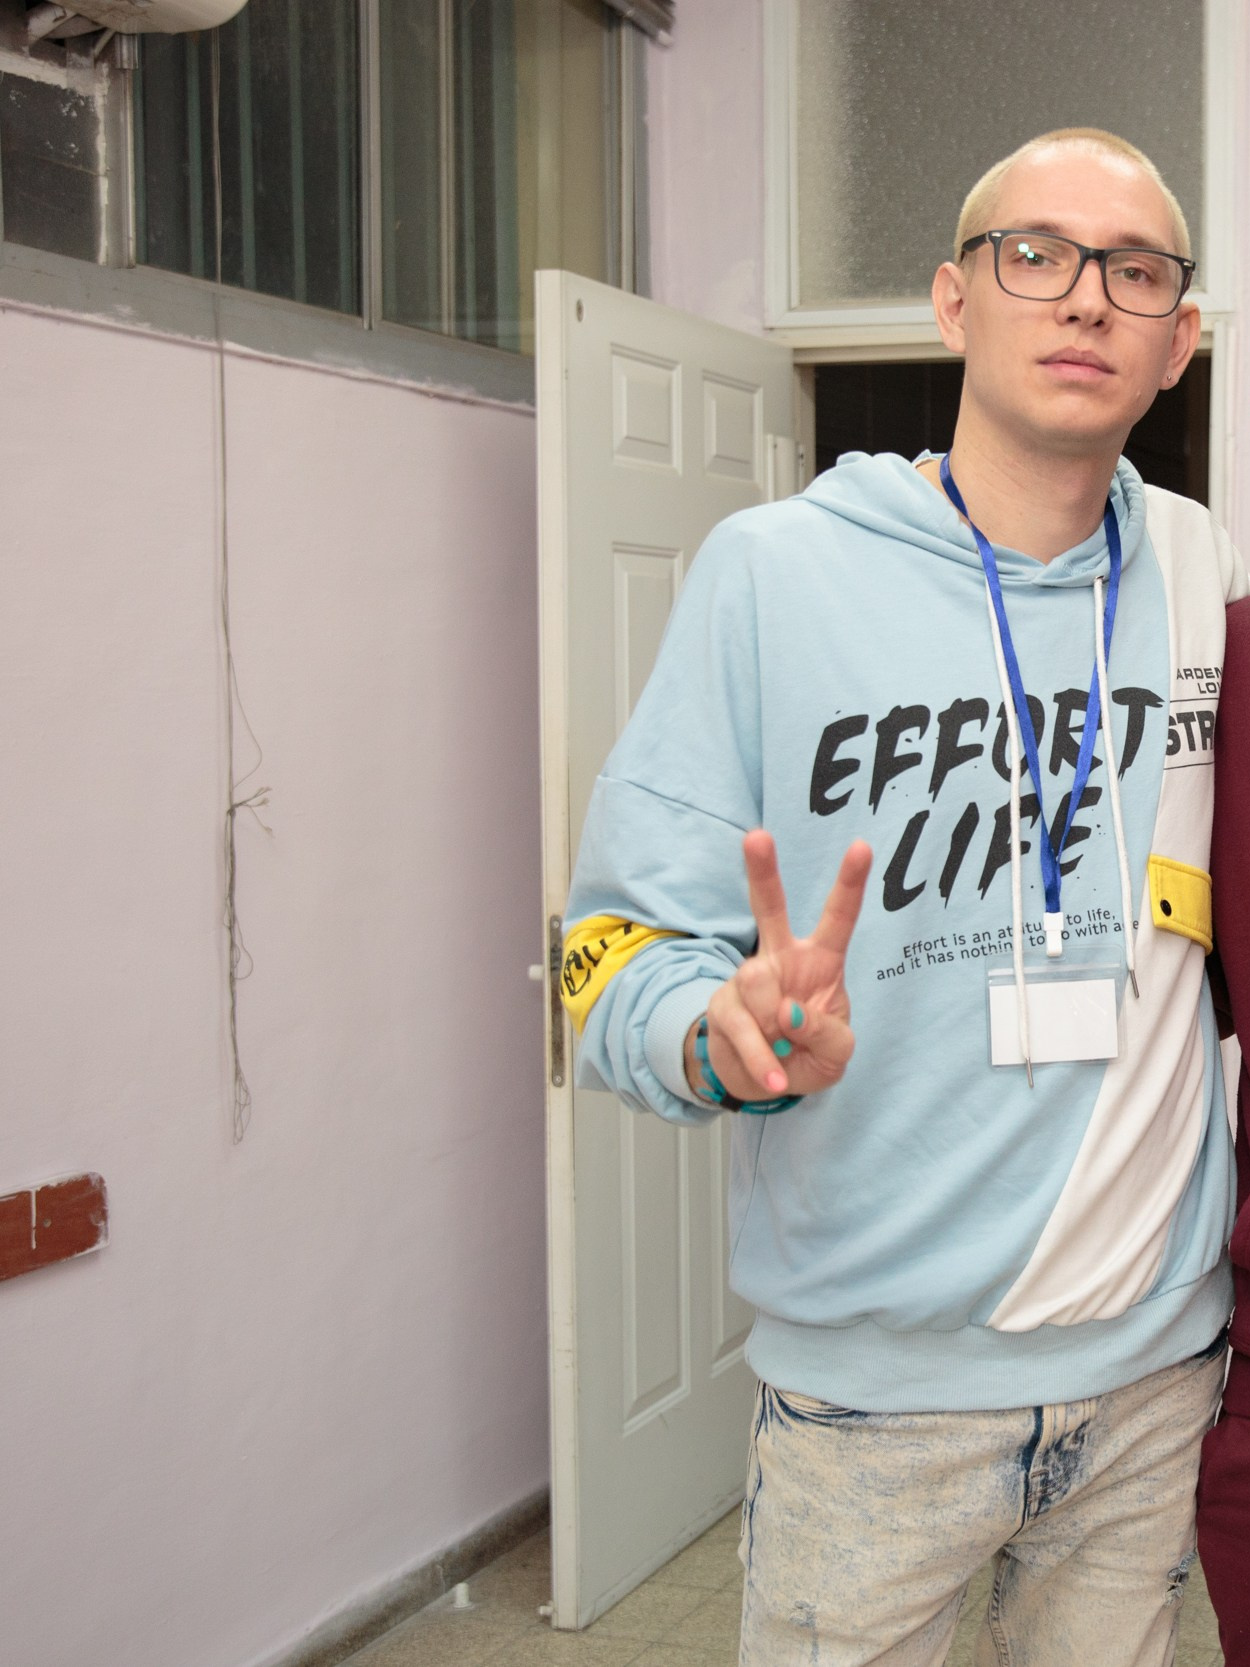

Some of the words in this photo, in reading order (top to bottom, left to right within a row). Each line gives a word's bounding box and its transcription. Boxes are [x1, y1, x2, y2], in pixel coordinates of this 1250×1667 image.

[809, 687, 1165, 815] EFFORT
[882, 787, 1103, 911] LIFE
[877, 962, 905, 981] and
[910, 956, 922, 970] it
[927, 951, 954, 966] has
[961, 941, 1014, 959] nothin
[1029, 934, 1045, 947] to
[1076, 919, 1108, 937] with
[1114, 919, 1140, 934] ae
[903, 935, 947, 958] Effort
[953, 933, 966, 946] is
[973, 931, 991, 943] an
[1066, 914, 1082, 926] to
[1087, 908, 1116, 922] life,
